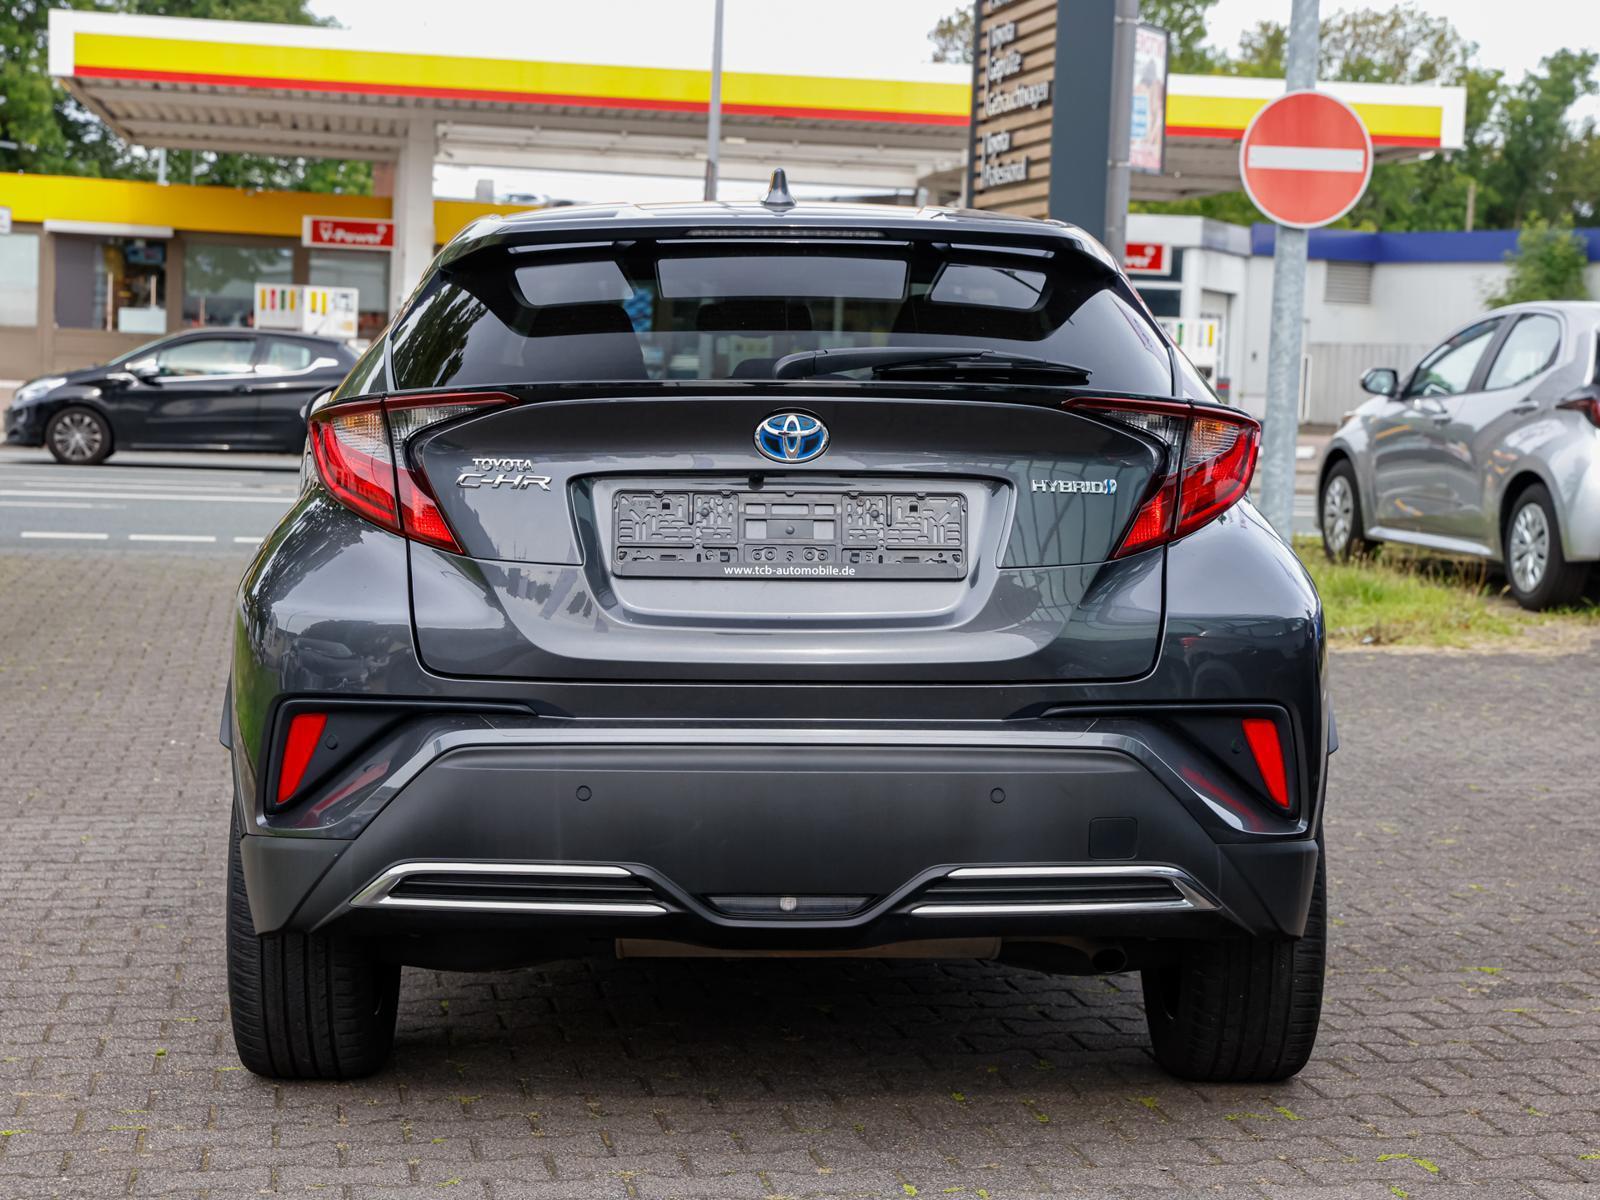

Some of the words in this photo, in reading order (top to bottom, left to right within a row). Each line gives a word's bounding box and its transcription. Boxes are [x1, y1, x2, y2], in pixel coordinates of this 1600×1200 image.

[472, 458, 534, 472] TOYOTA
[455, 473, 553, 491] C-HR
[1031, 479, 1104, 494] HYBRID
[724, 564, 856, 576] www.tcb-automobile.de
